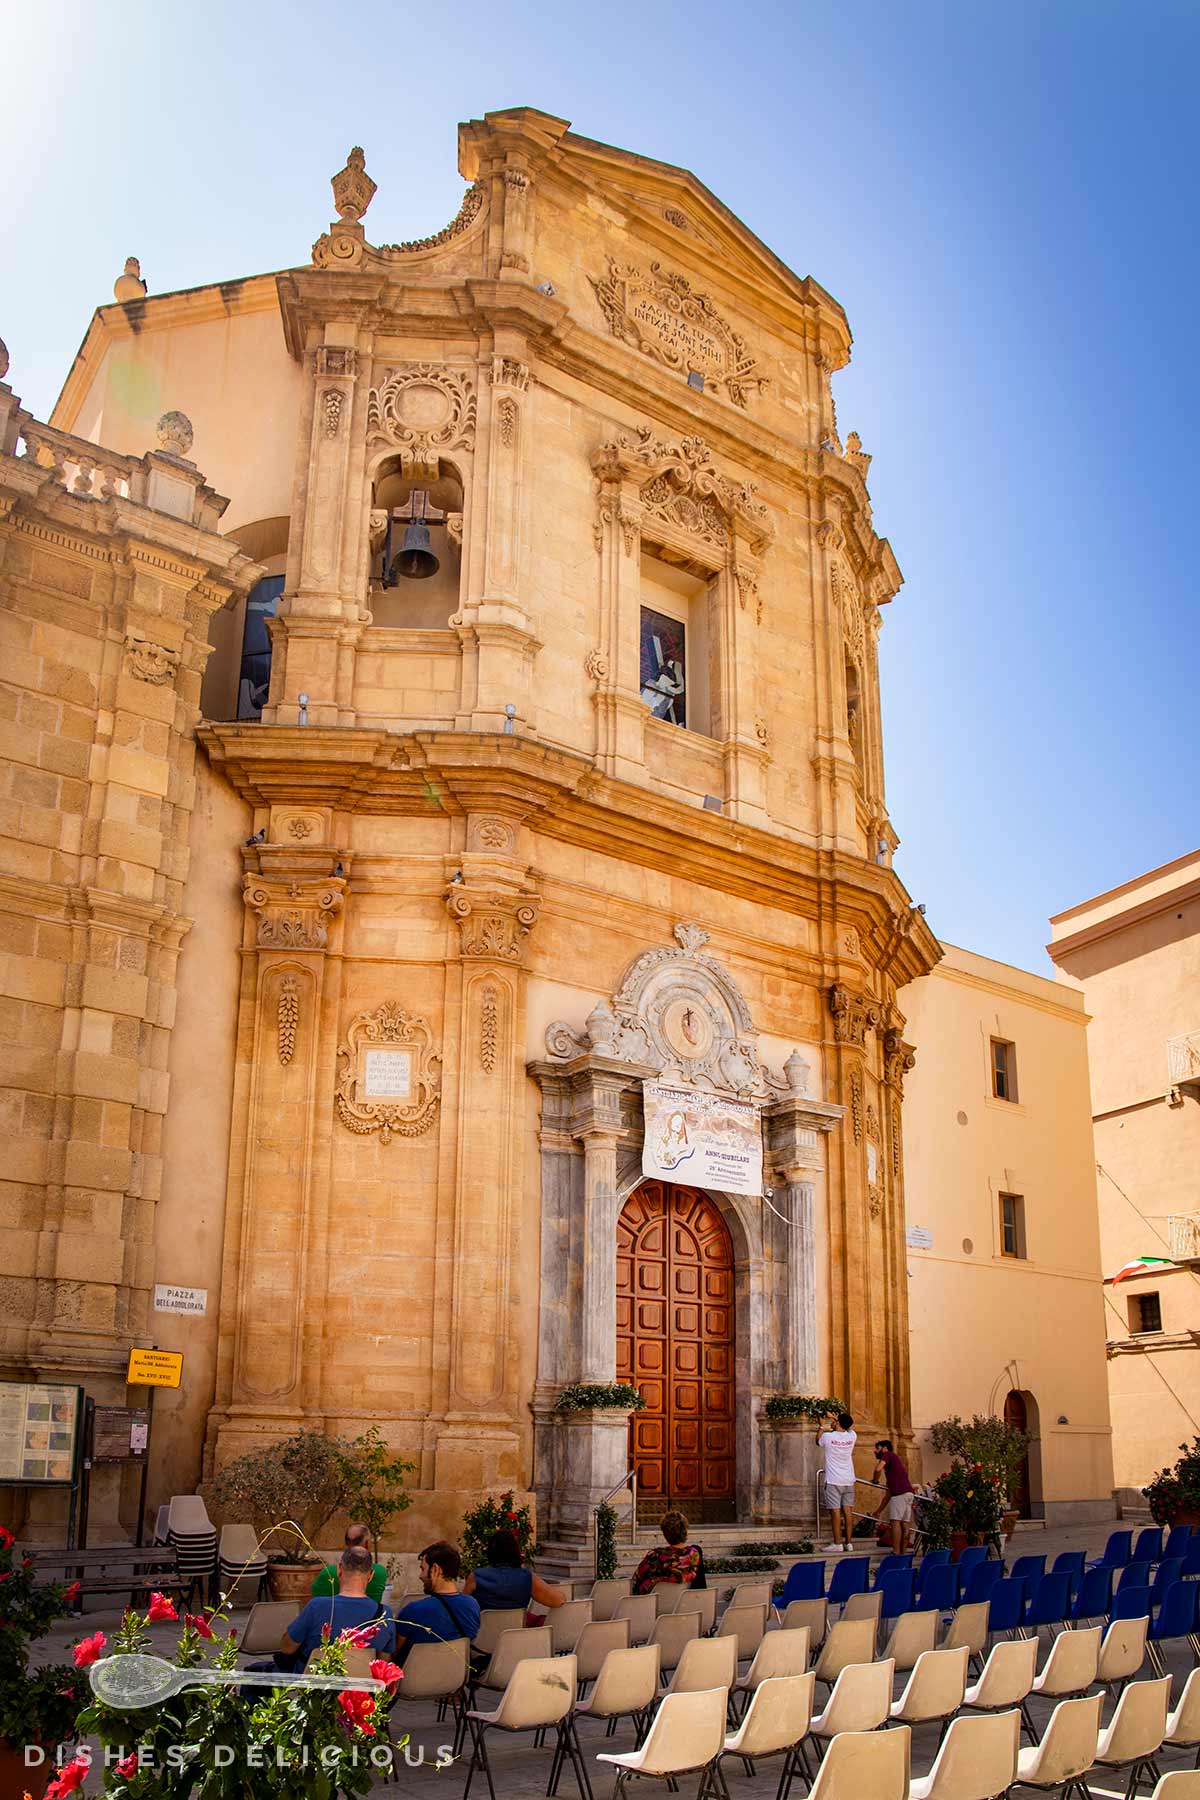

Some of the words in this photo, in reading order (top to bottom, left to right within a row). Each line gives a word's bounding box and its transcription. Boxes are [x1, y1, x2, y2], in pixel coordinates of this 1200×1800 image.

[671, 328, 696, 347] SUNT
[699, 343, 722, 363] MIHI
[167, 1289, 195, 1299] PIAZZA
